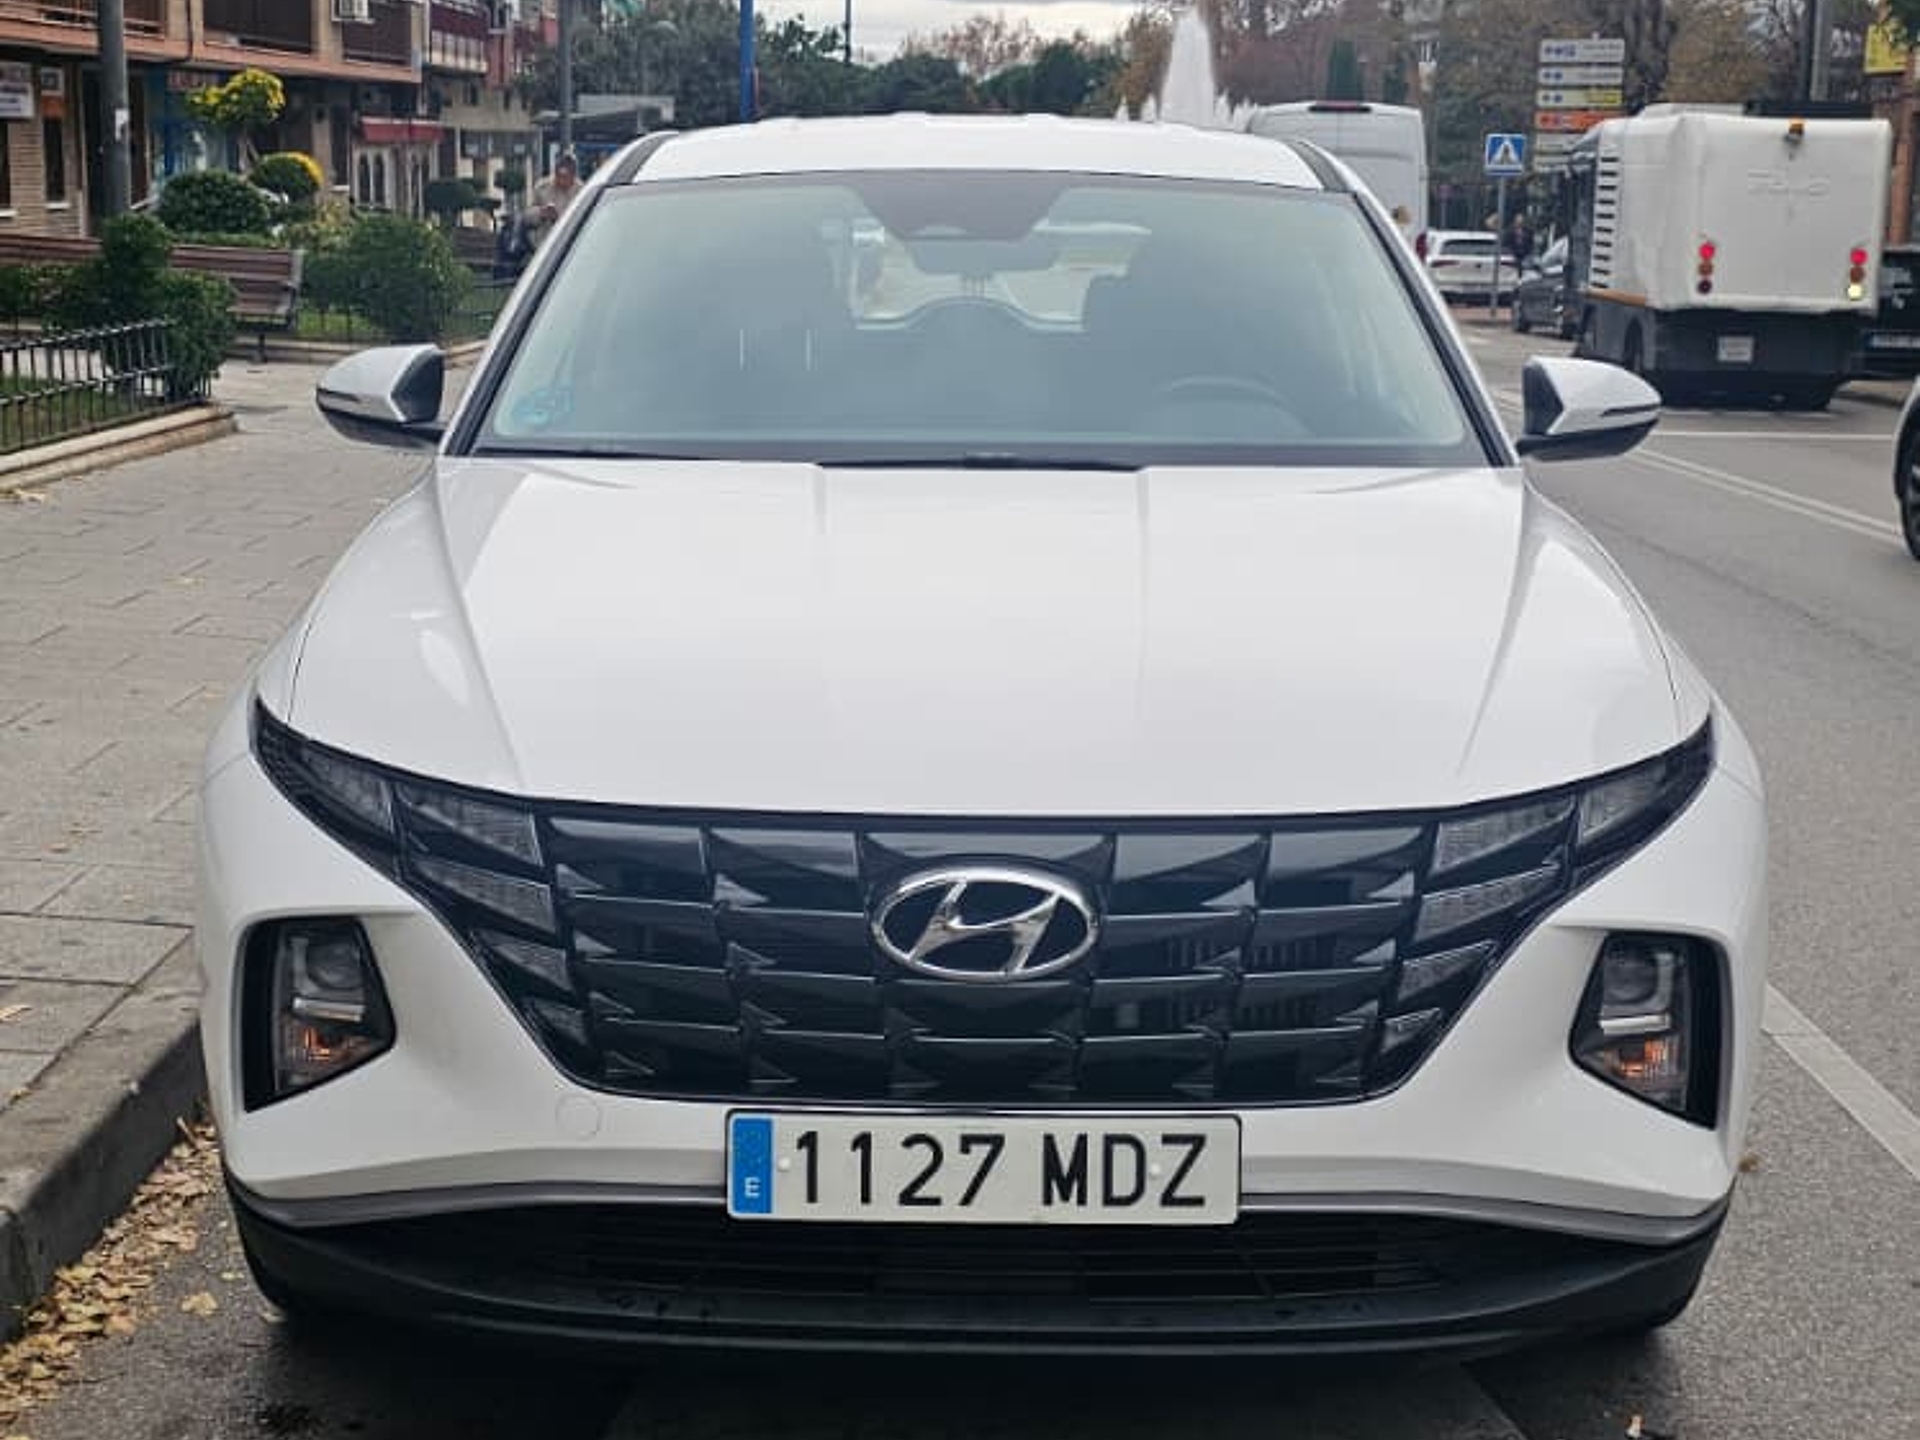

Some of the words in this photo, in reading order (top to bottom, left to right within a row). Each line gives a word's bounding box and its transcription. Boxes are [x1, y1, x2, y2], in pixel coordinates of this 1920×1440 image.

[744, 1177, 760, 1198] E
[795, 1130, 1005, 1207] 1127
[1041, 1132, 1207, 1208] MDZ
